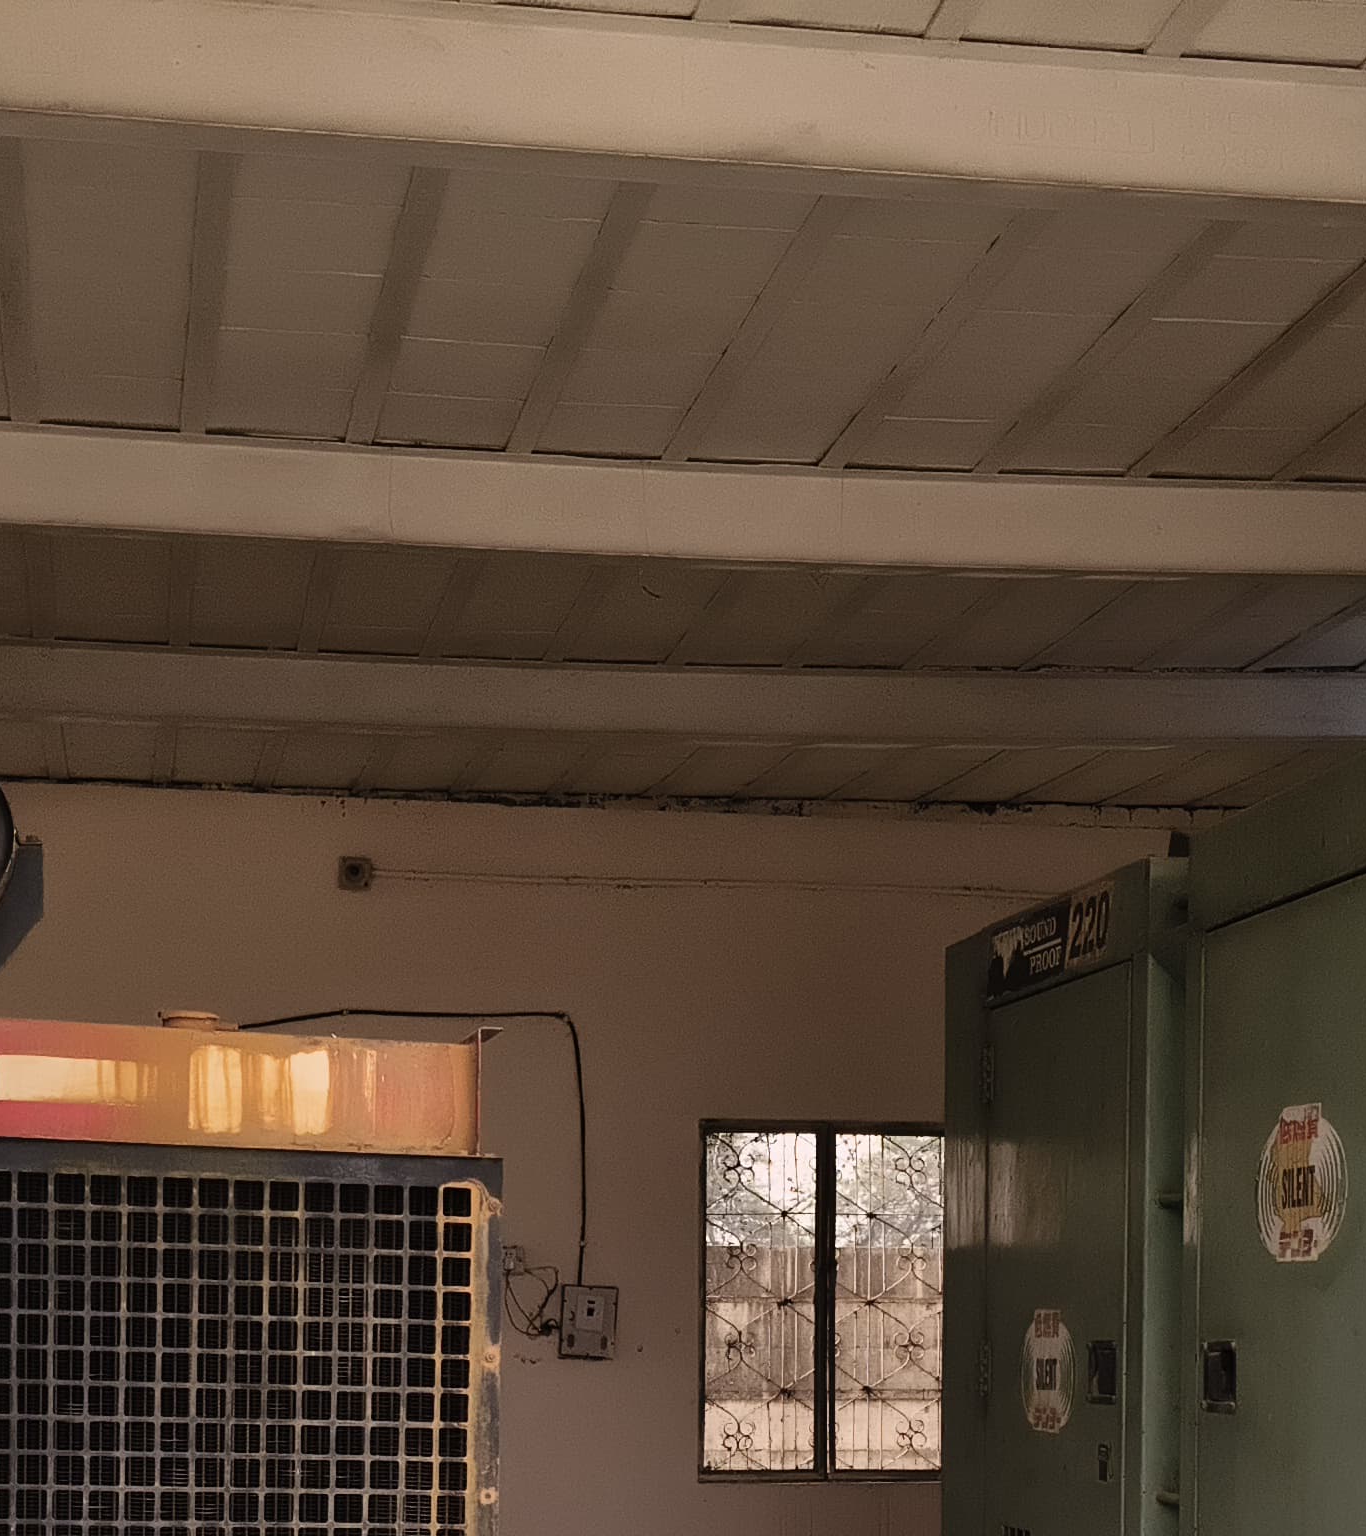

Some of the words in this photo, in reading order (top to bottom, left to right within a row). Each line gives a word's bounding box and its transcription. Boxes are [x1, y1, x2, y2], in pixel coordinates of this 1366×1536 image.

[1023, 916, 1057, 945] SOUND
[1068, 890, 1111, 961] 220
[1029, 945, 1063, 976] PROOF
[1281, 1164, 1316, 1209] SILENT
